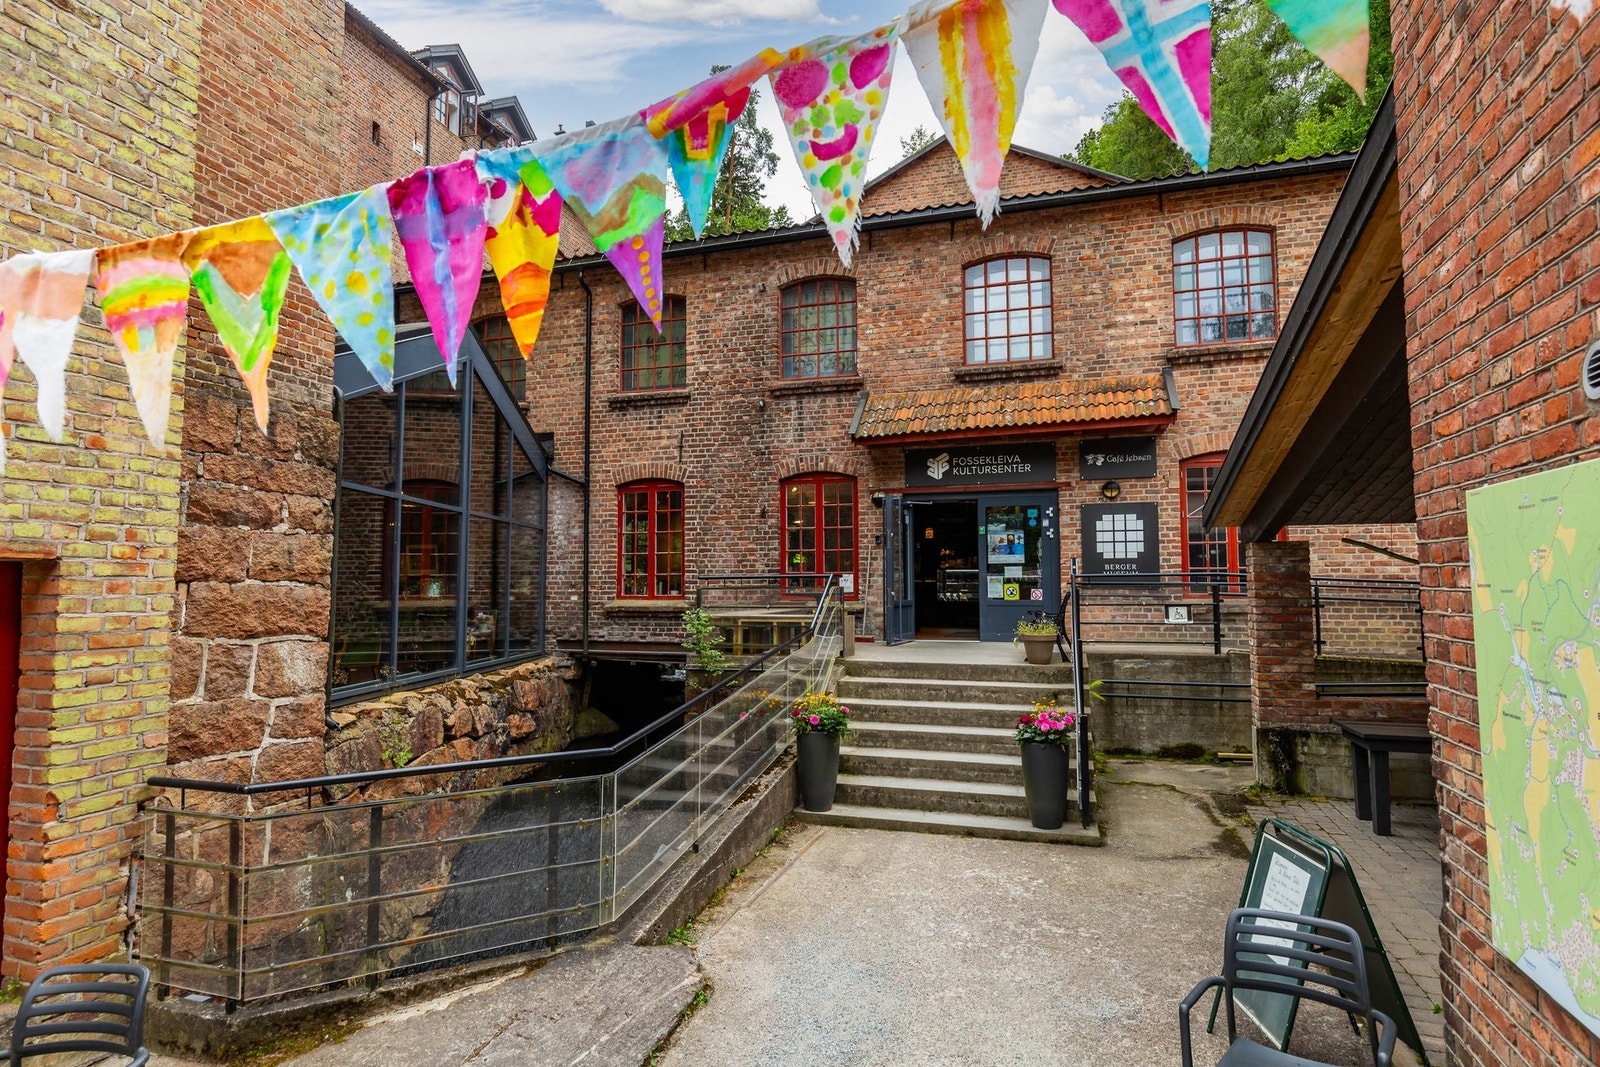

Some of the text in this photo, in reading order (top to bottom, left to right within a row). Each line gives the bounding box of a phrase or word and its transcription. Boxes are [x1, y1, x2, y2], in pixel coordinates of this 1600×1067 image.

[952, 454, 1021, 466] FOSSEKLEIVA
[1106, 453, 1152, 464] Café Jebsen
[952, 463, 1031, 475] KULTURSENTER
[1104, 563, 1137, 571] BERGER
